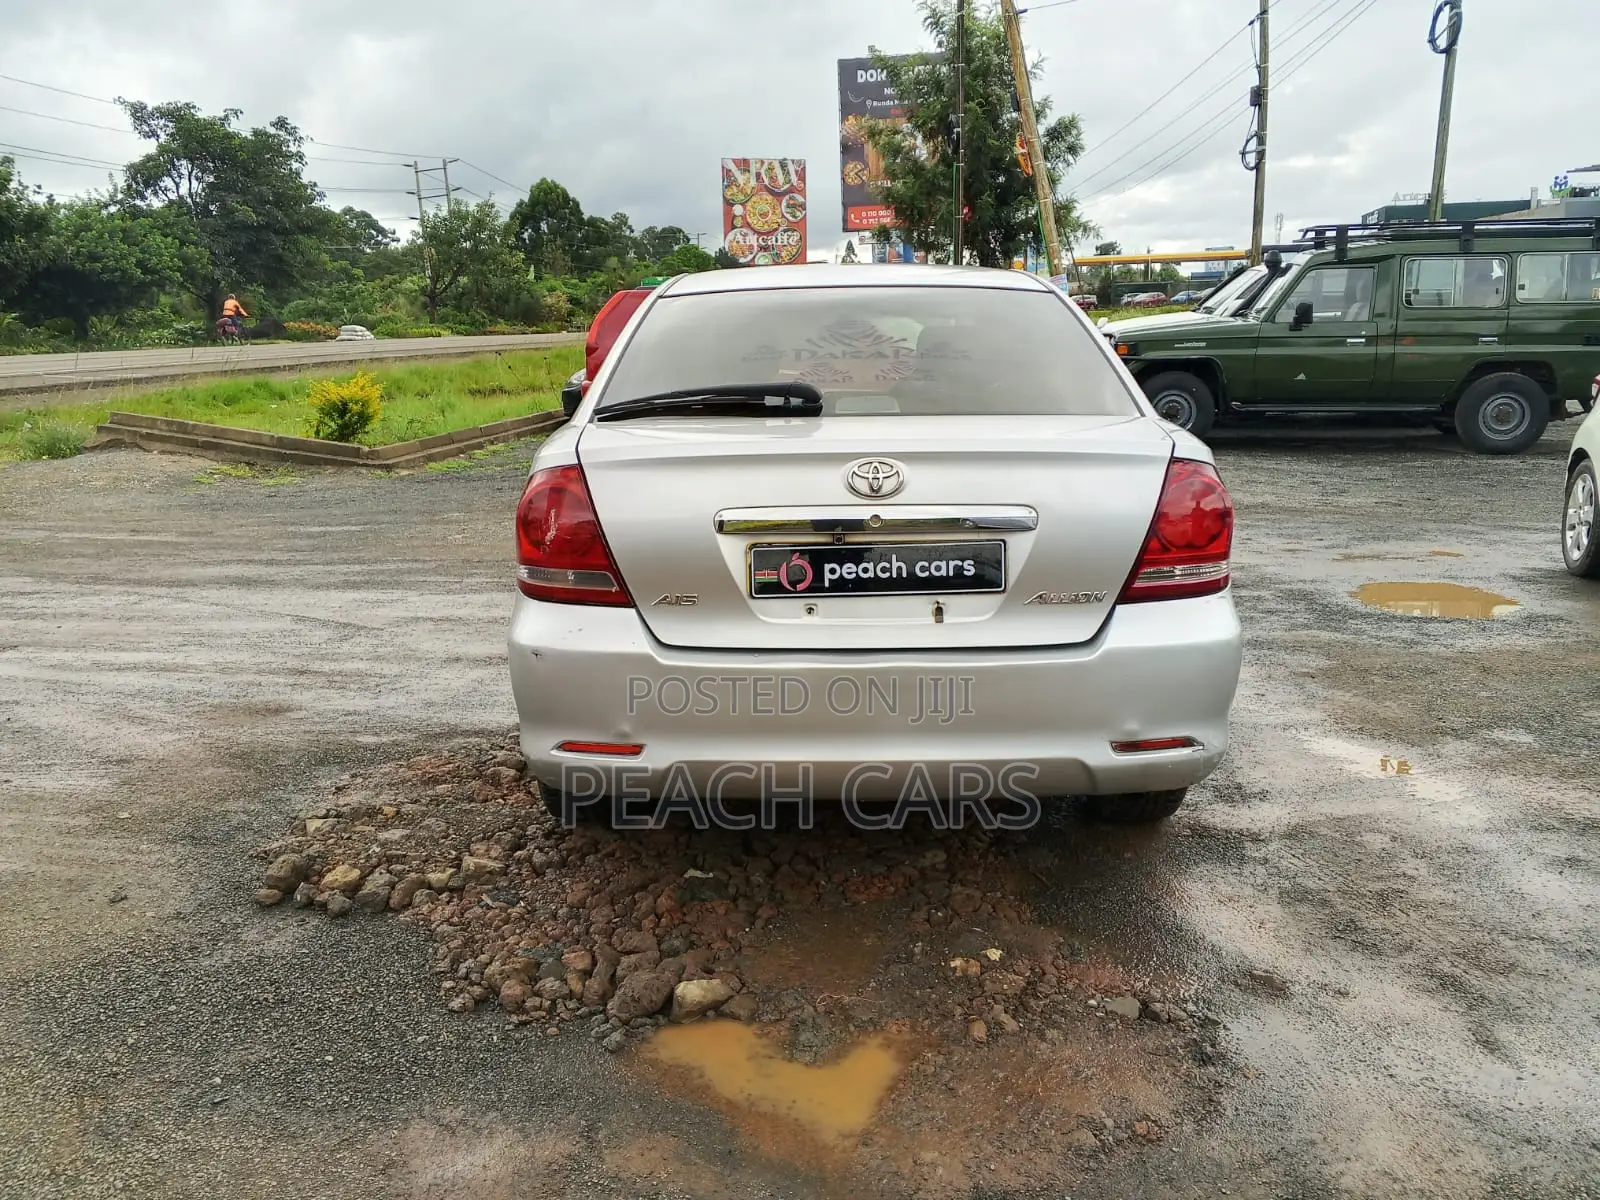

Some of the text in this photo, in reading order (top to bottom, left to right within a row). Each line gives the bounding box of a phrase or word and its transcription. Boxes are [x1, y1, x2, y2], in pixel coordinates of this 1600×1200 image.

[824, 554, 976, 588] peach cars
[1023, 590, 1108, 606] ALLION
